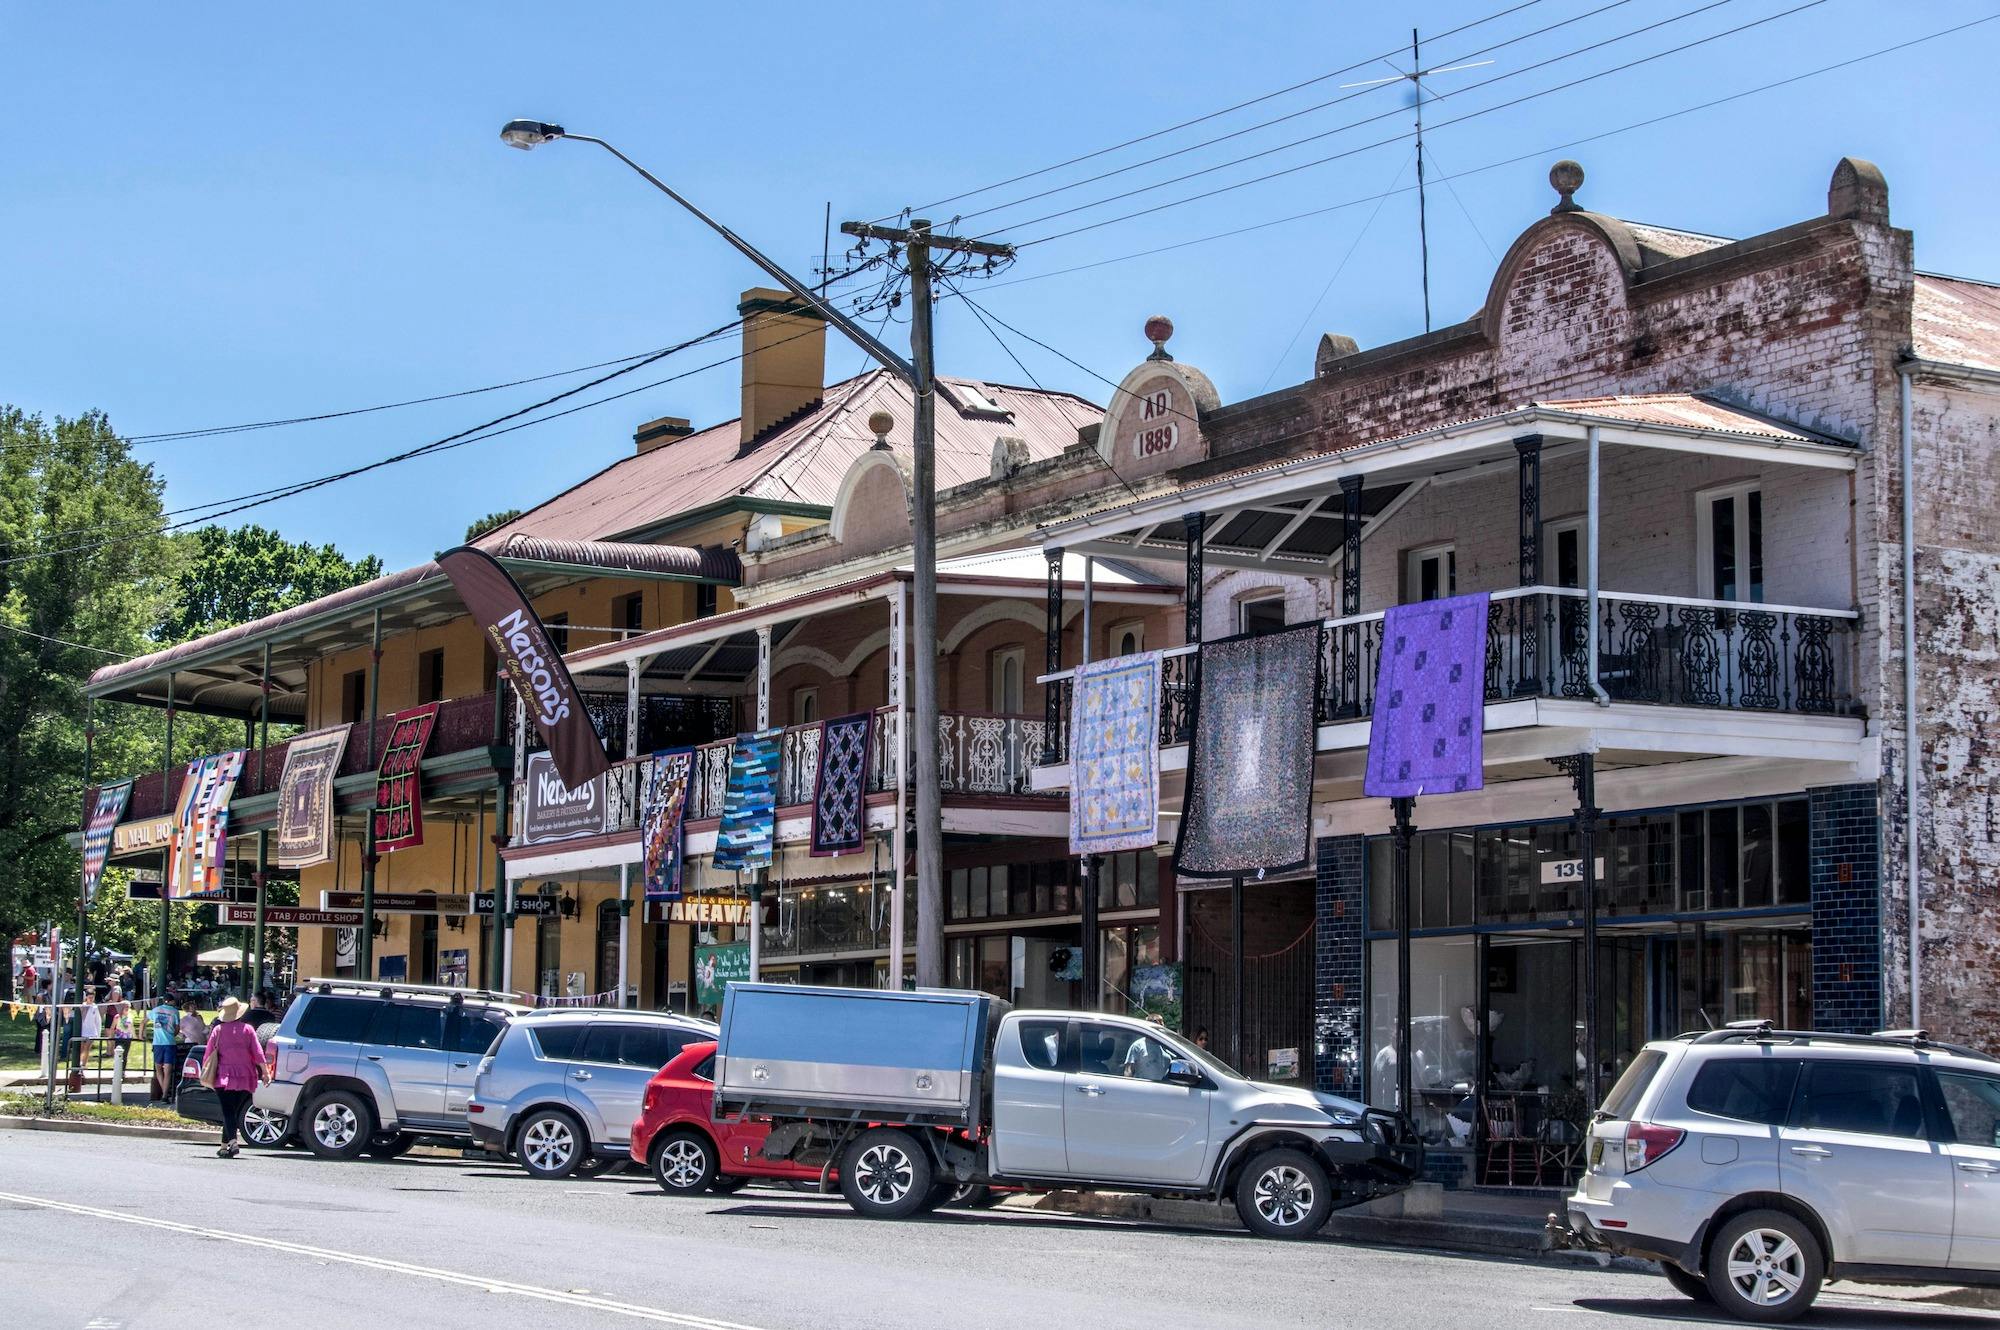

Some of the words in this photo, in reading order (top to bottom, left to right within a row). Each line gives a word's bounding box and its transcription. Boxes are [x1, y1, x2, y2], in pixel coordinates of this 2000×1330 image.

[1144, 392, 1167, 420] AD
[1139, 426, 1172, 457] 1889
[488, 624, 508, 653] Bakery
[497, 608, 570, 727] Nerson's
[127, 826, 152, 847] MAIL
[478, 898, 519, 909] BOE
[521, 900, 551, 910] SHOP
[709, 896, 716, 905] &
[718, 896, 748, 906] Bakery
[233, 910, 257, 919] BIST
[274, 912, 291, 920] TAB
[299, 912, 332, 922] BOTTLE
[334, 915, 358, 923] SHOP
